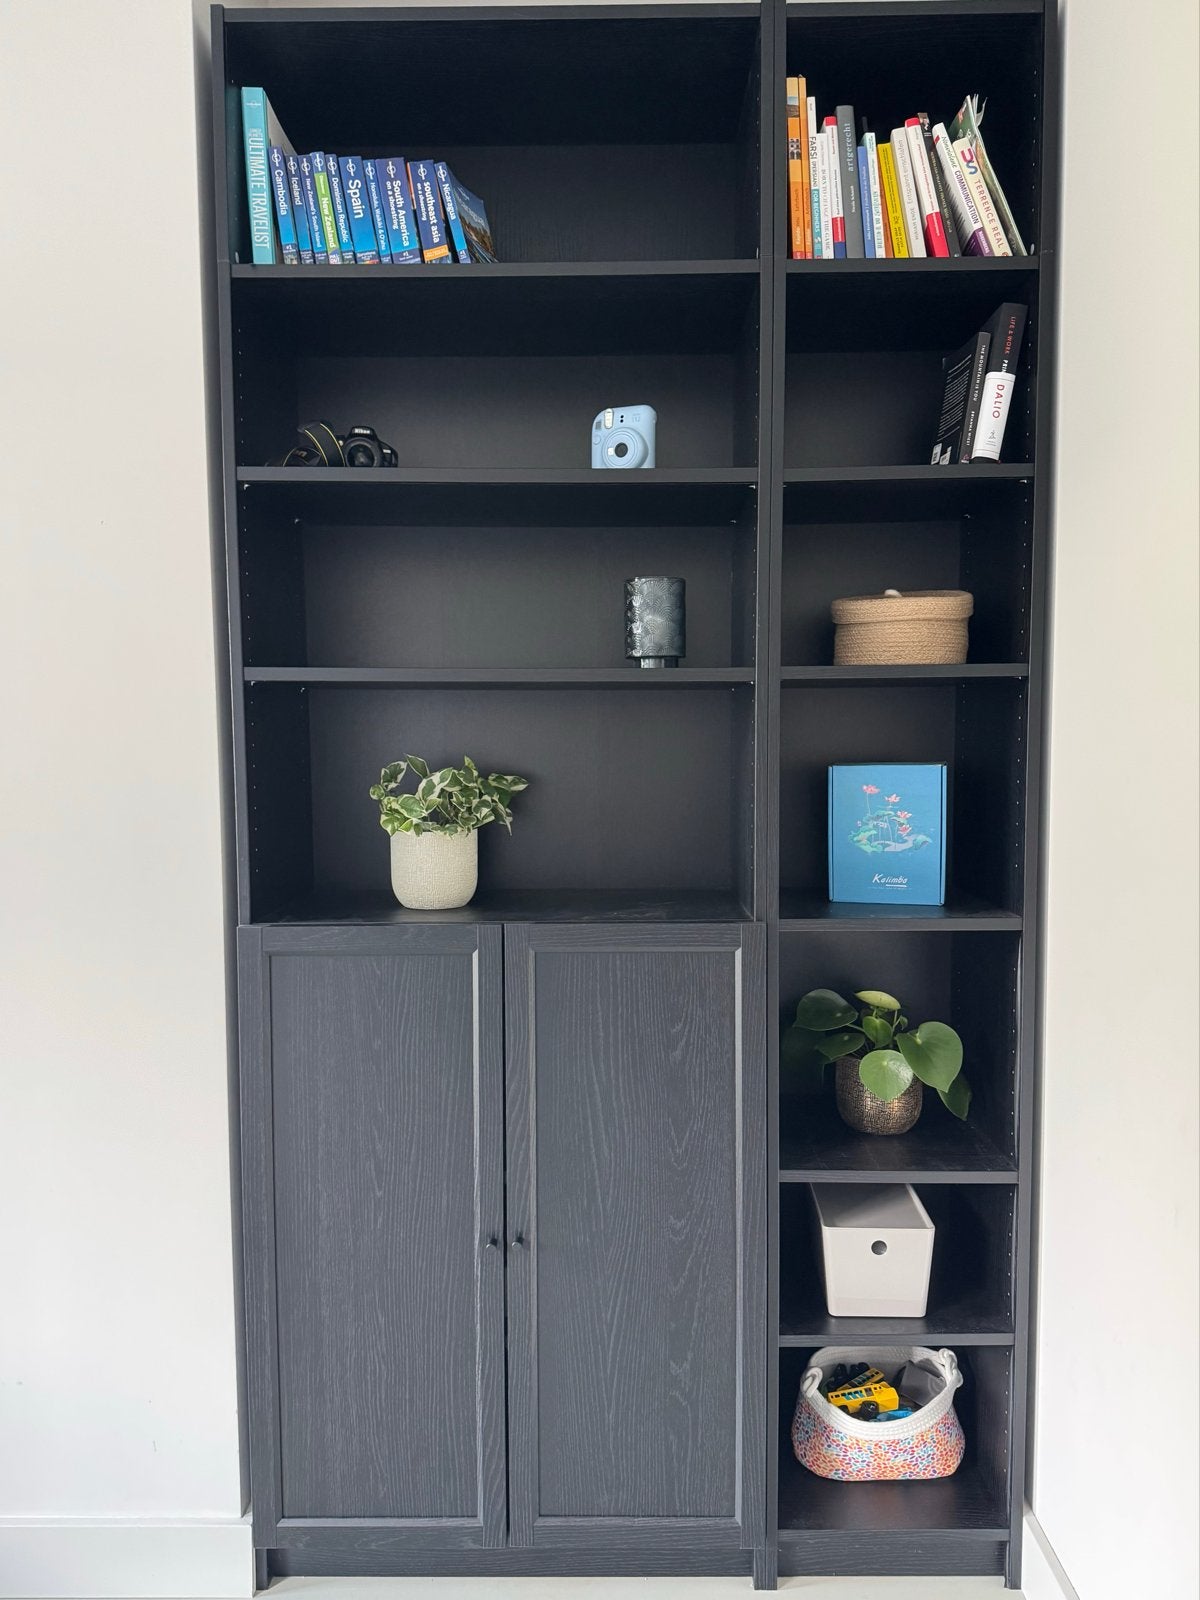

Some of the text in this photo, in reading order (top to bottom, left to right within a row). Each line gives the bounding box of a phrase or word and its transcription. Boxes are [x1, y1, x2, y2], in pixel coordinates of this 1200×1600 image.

[249, 138, 265, 188] ULTIMATE
[844, 124, 853, 171] artgerecht
[275, 170, 288, 215] Cambodia
[292, 177, 302, 205] Iceland
[347, 180, 364, 218] Spain
[393, 180, 404, 207] South
[904, 174, 913, 204] Entspannt
[942, 137, 957, 168] Nonviolent
[955, 171, 979, 224] COMMUNICATION
[253, 192, 269, 249] TRAVELIST
[322, 198, 330, 214] New
[332, 178, 342, 213] Dominican
[339, 214, 348, 242] Republic
[386, 181, 391, 190] on
[389, 196, 398, 229] shoestring
[424, 182, 437, 224] southeast
[431, 226, 440, 243] asia
[443, 184, 456, 220] Nicaragua
[975, 179, 995, 224] TERRENCE
[992, 226, 1004, 248] REAL
[325, 216, 336, 248] Zealand
[398, 210, 411, 246] America
[993, 384, 1005, 418] DALIO
[872, 873, 908, 884] Kalimba
